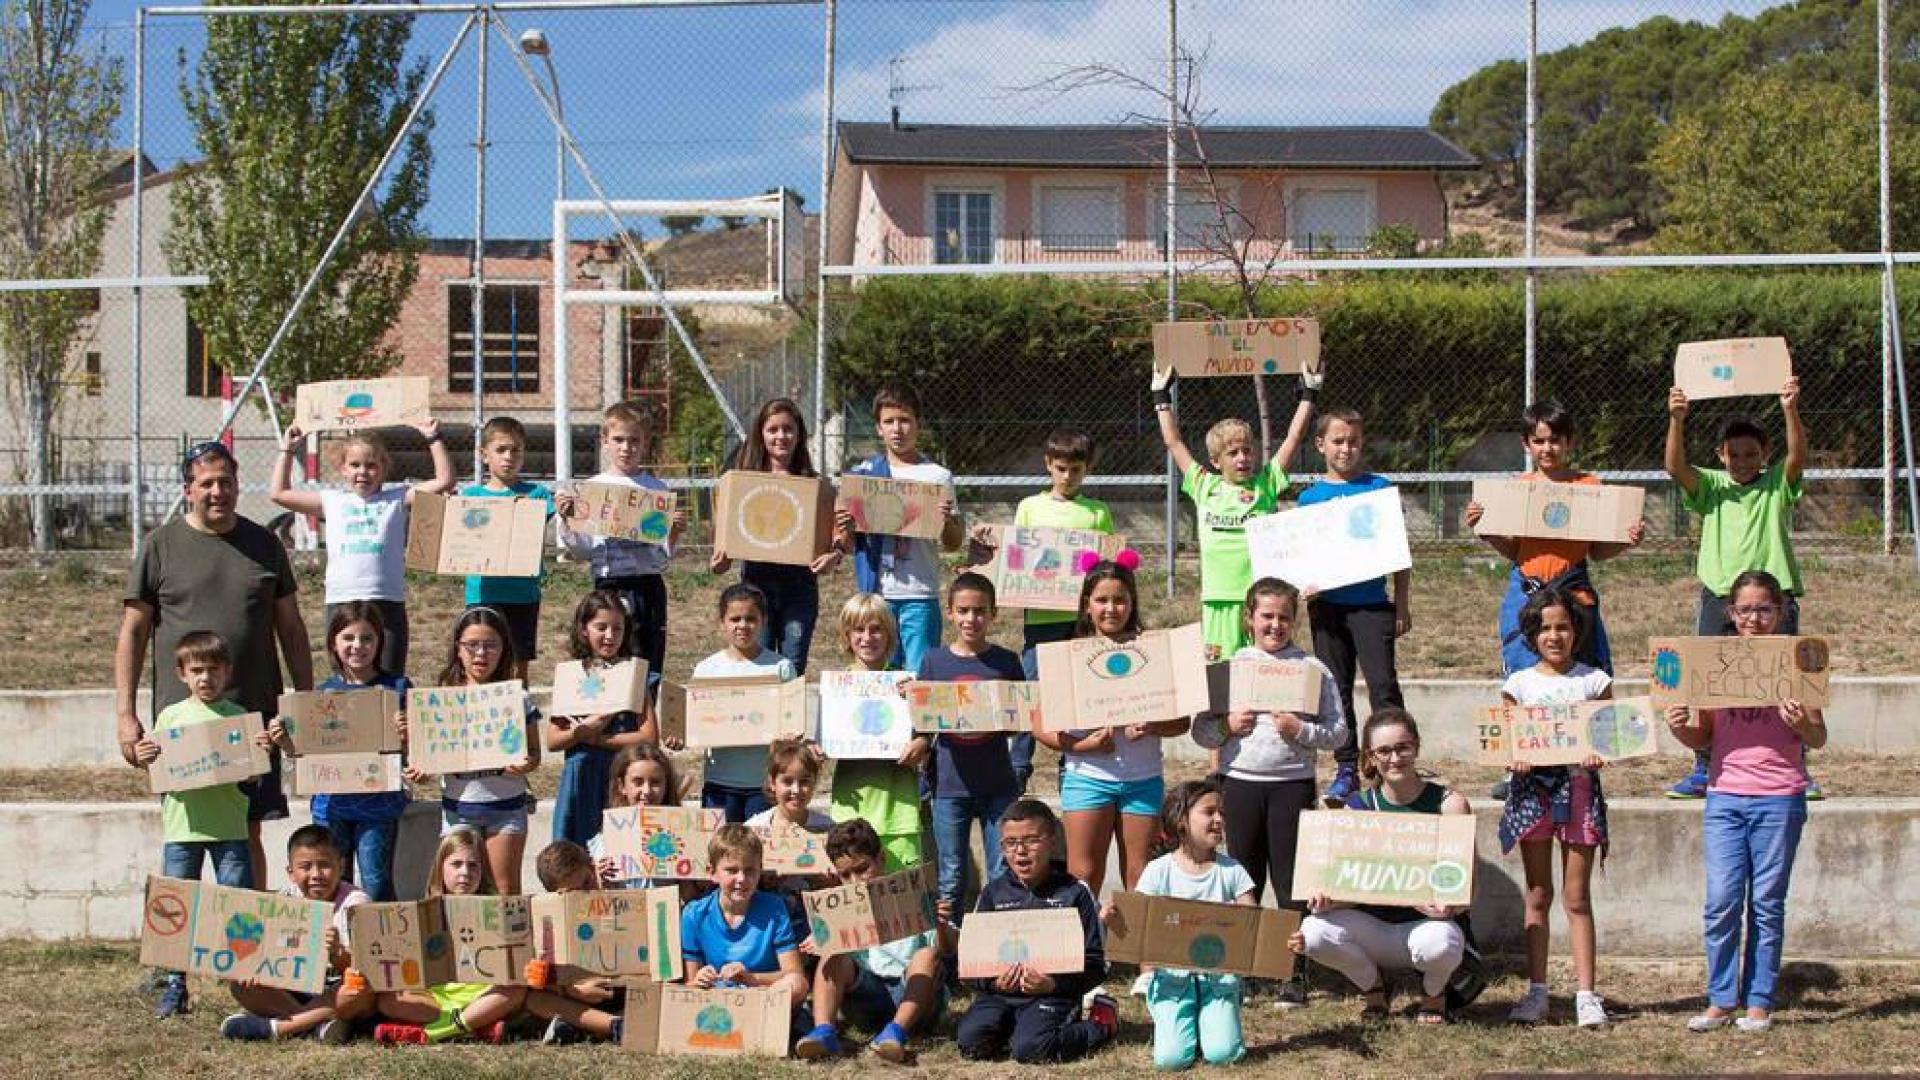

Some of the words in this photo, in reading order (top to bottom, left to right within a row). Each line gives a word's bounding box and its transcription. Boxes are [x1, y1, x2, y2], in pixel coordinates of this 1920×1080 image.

[1524, 704, 1581, 722] TIME
[1335, 858, 1467, 893] MUNDO
[193, 945, 237, 973] TO
[255, 955, 309, 982] ACT
